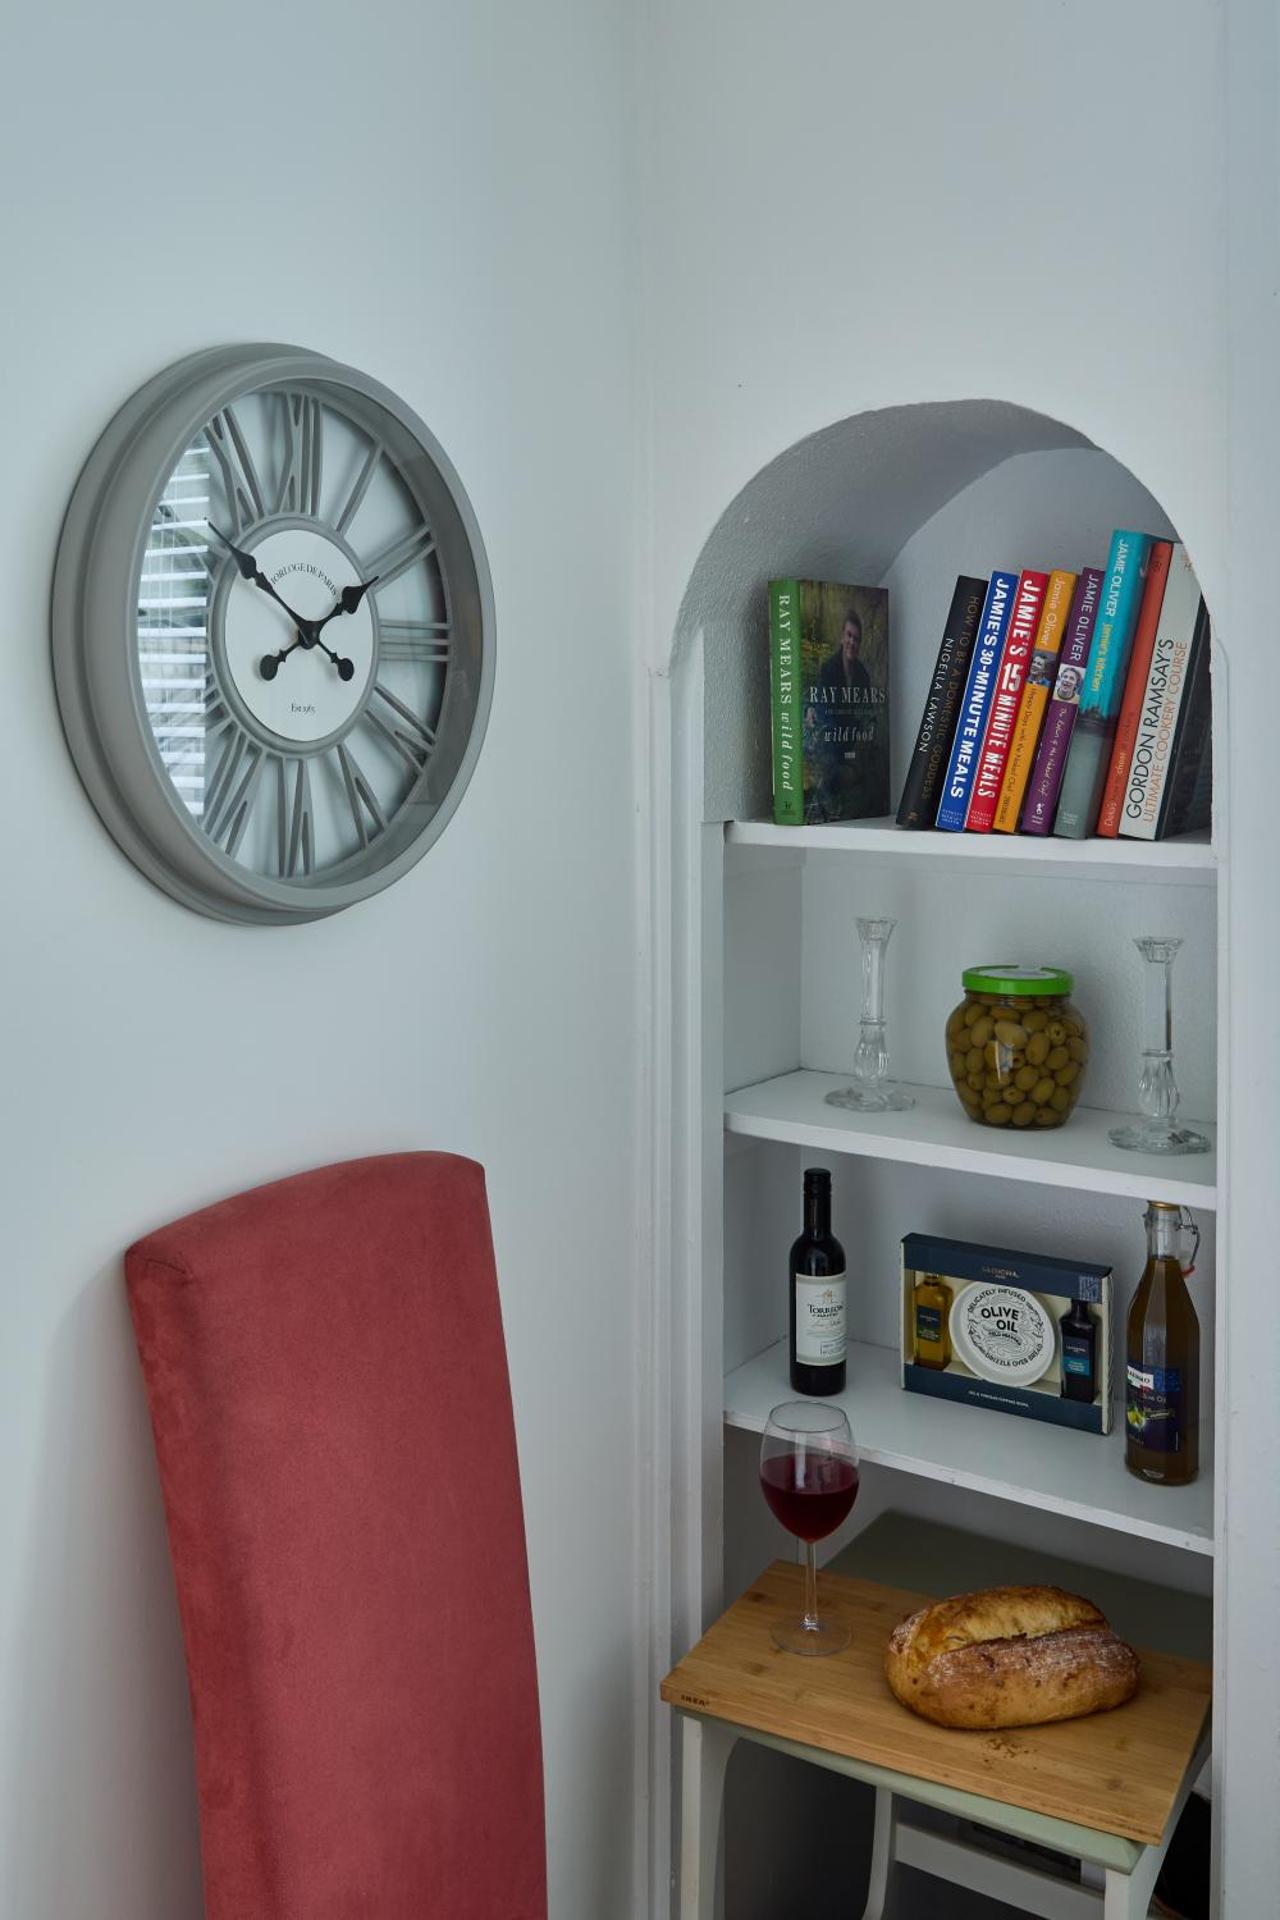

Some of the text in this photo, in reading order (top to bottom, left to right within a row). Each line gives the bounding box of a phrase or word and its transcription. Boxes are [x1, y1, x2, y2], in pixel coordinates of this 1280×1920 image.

[1113, 538, 1129, 573] JAMIE
[983, 578, 1009, 646] JAMIE'S
[1008, 579, 1041, 657] JAMIE'S
[1040, 576, 1065, 645] Jamie Oliver
[1069, 574, 1098, 661] JAMIE OLIVER
[1104, 575, 1121, 616] OLIVER
[779, 595, 792, 790] RAY MEARS wild food
[809, 686, 886, 704] RAY MEARS
[918, 638, 953, 752] NIGELLA LAWSON
[921, 596, 979, 800] HOW TO BE A DOMESTIC GODDESS
[963, 648, 993, 737] 30-MINUTE
[1000, 662, 1023, 692] 15
[988, 694, 1015, 747] MINUTE
[1125, 637, 1173, 818] GORDON RAMSAY'S
[1143, 641, 1186, 822] ULTIMATE COOKERY COURSE
[950, 739, 973, 798] MEALS
[977, 751, 1002, 798] MEALS
[968, 1289, 996, 1313] DELICATELY
[981, 1306, 1019, 1320] OLIVE
[996, 1319, 1018, 1333] OIL
